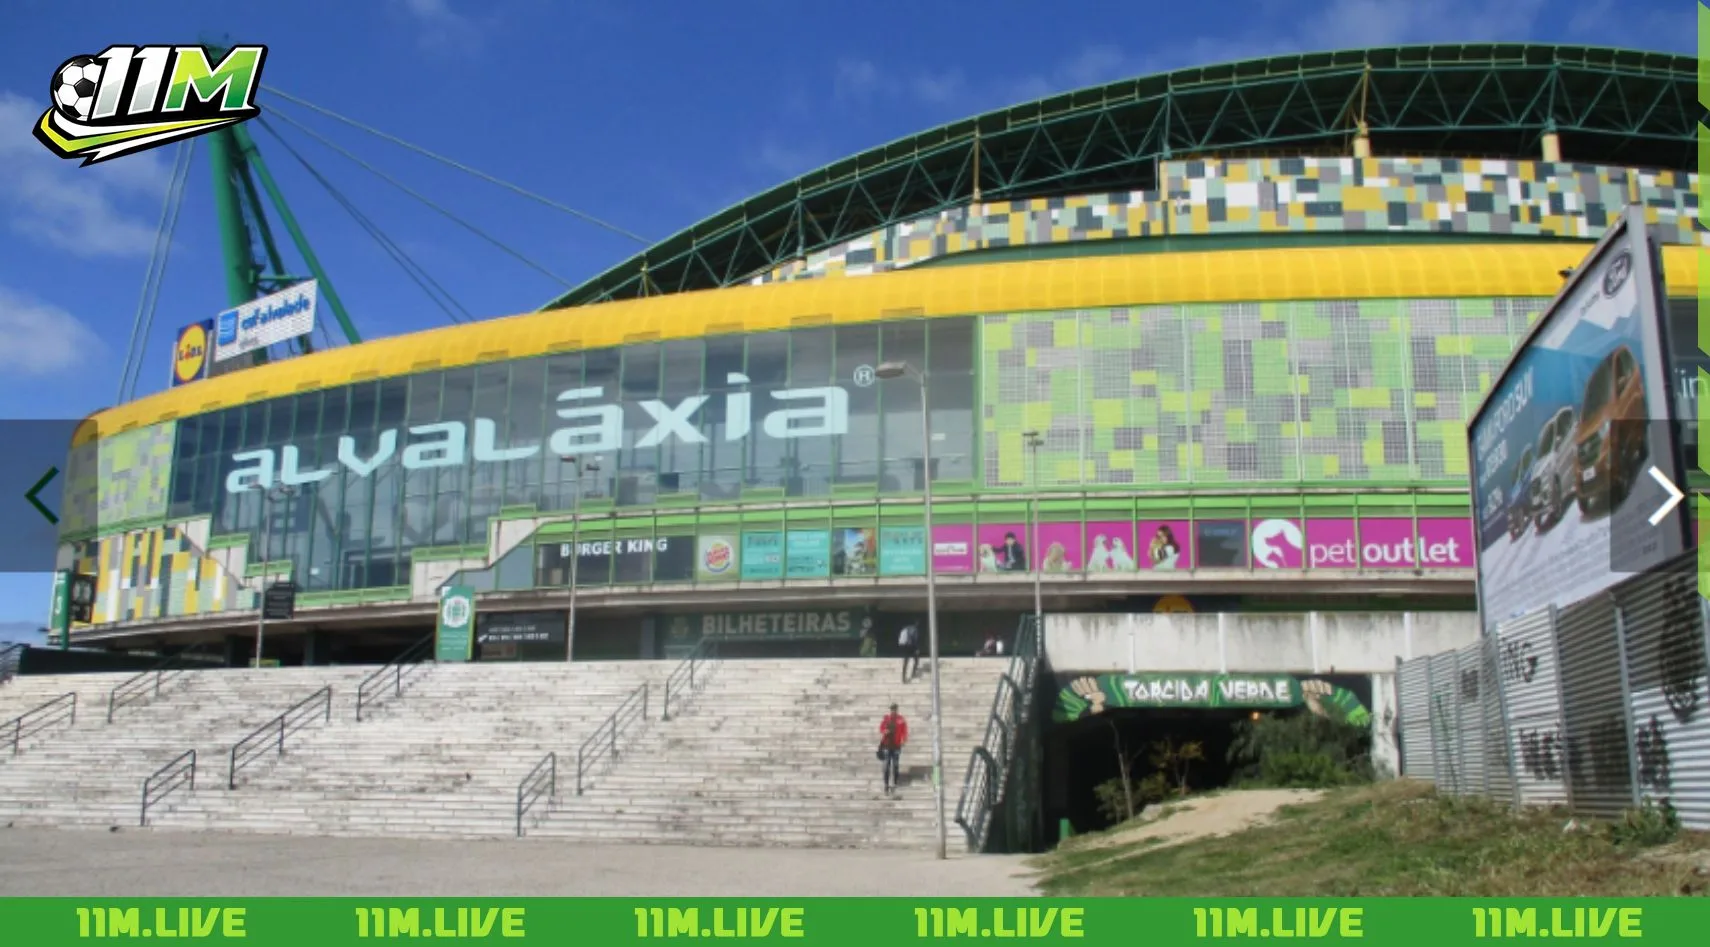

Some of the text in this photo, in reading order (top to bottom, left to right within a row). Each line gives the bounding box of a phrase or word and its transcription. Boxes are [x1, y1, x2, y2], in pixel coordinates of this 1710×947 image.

[560, 537, 668, 557] BRGER KING
[1310, 537, 1460, 568] pet outlet
[702, 611, 851, 634] BILHETEIRAS
[1123, 679, 1292, 703] TORCIDA VERDE
